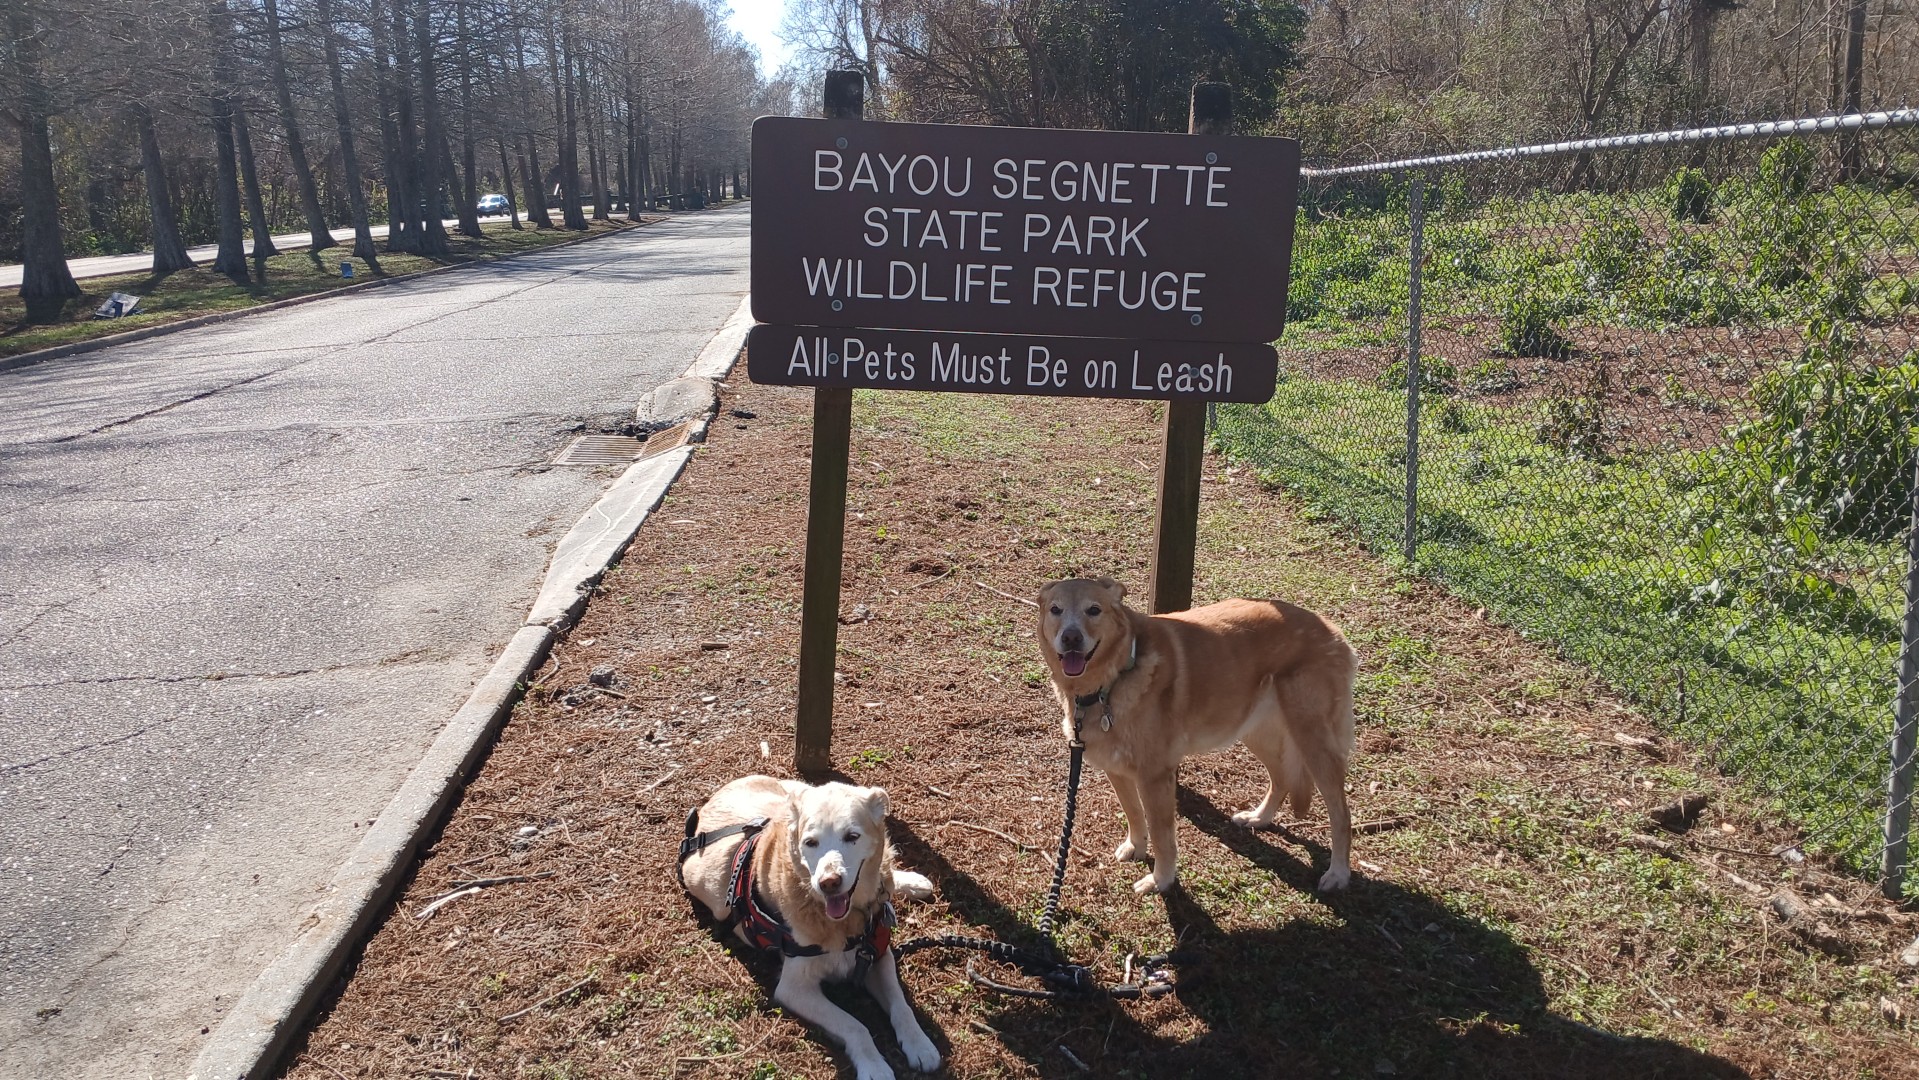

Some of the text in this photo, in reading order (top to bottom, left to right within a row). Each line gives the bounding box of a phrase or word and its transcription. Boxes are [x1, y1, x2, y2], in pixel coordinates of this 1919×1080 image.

[813, 149, 1232, 208] BAYOU SEGNETTE
[863, 206, 1150, 258] STATE PARK
[802, 257, 1206, 312] WILDLIFE REFUGE
[787, 336, 1233, 394] All Pets Must Be on Leash
